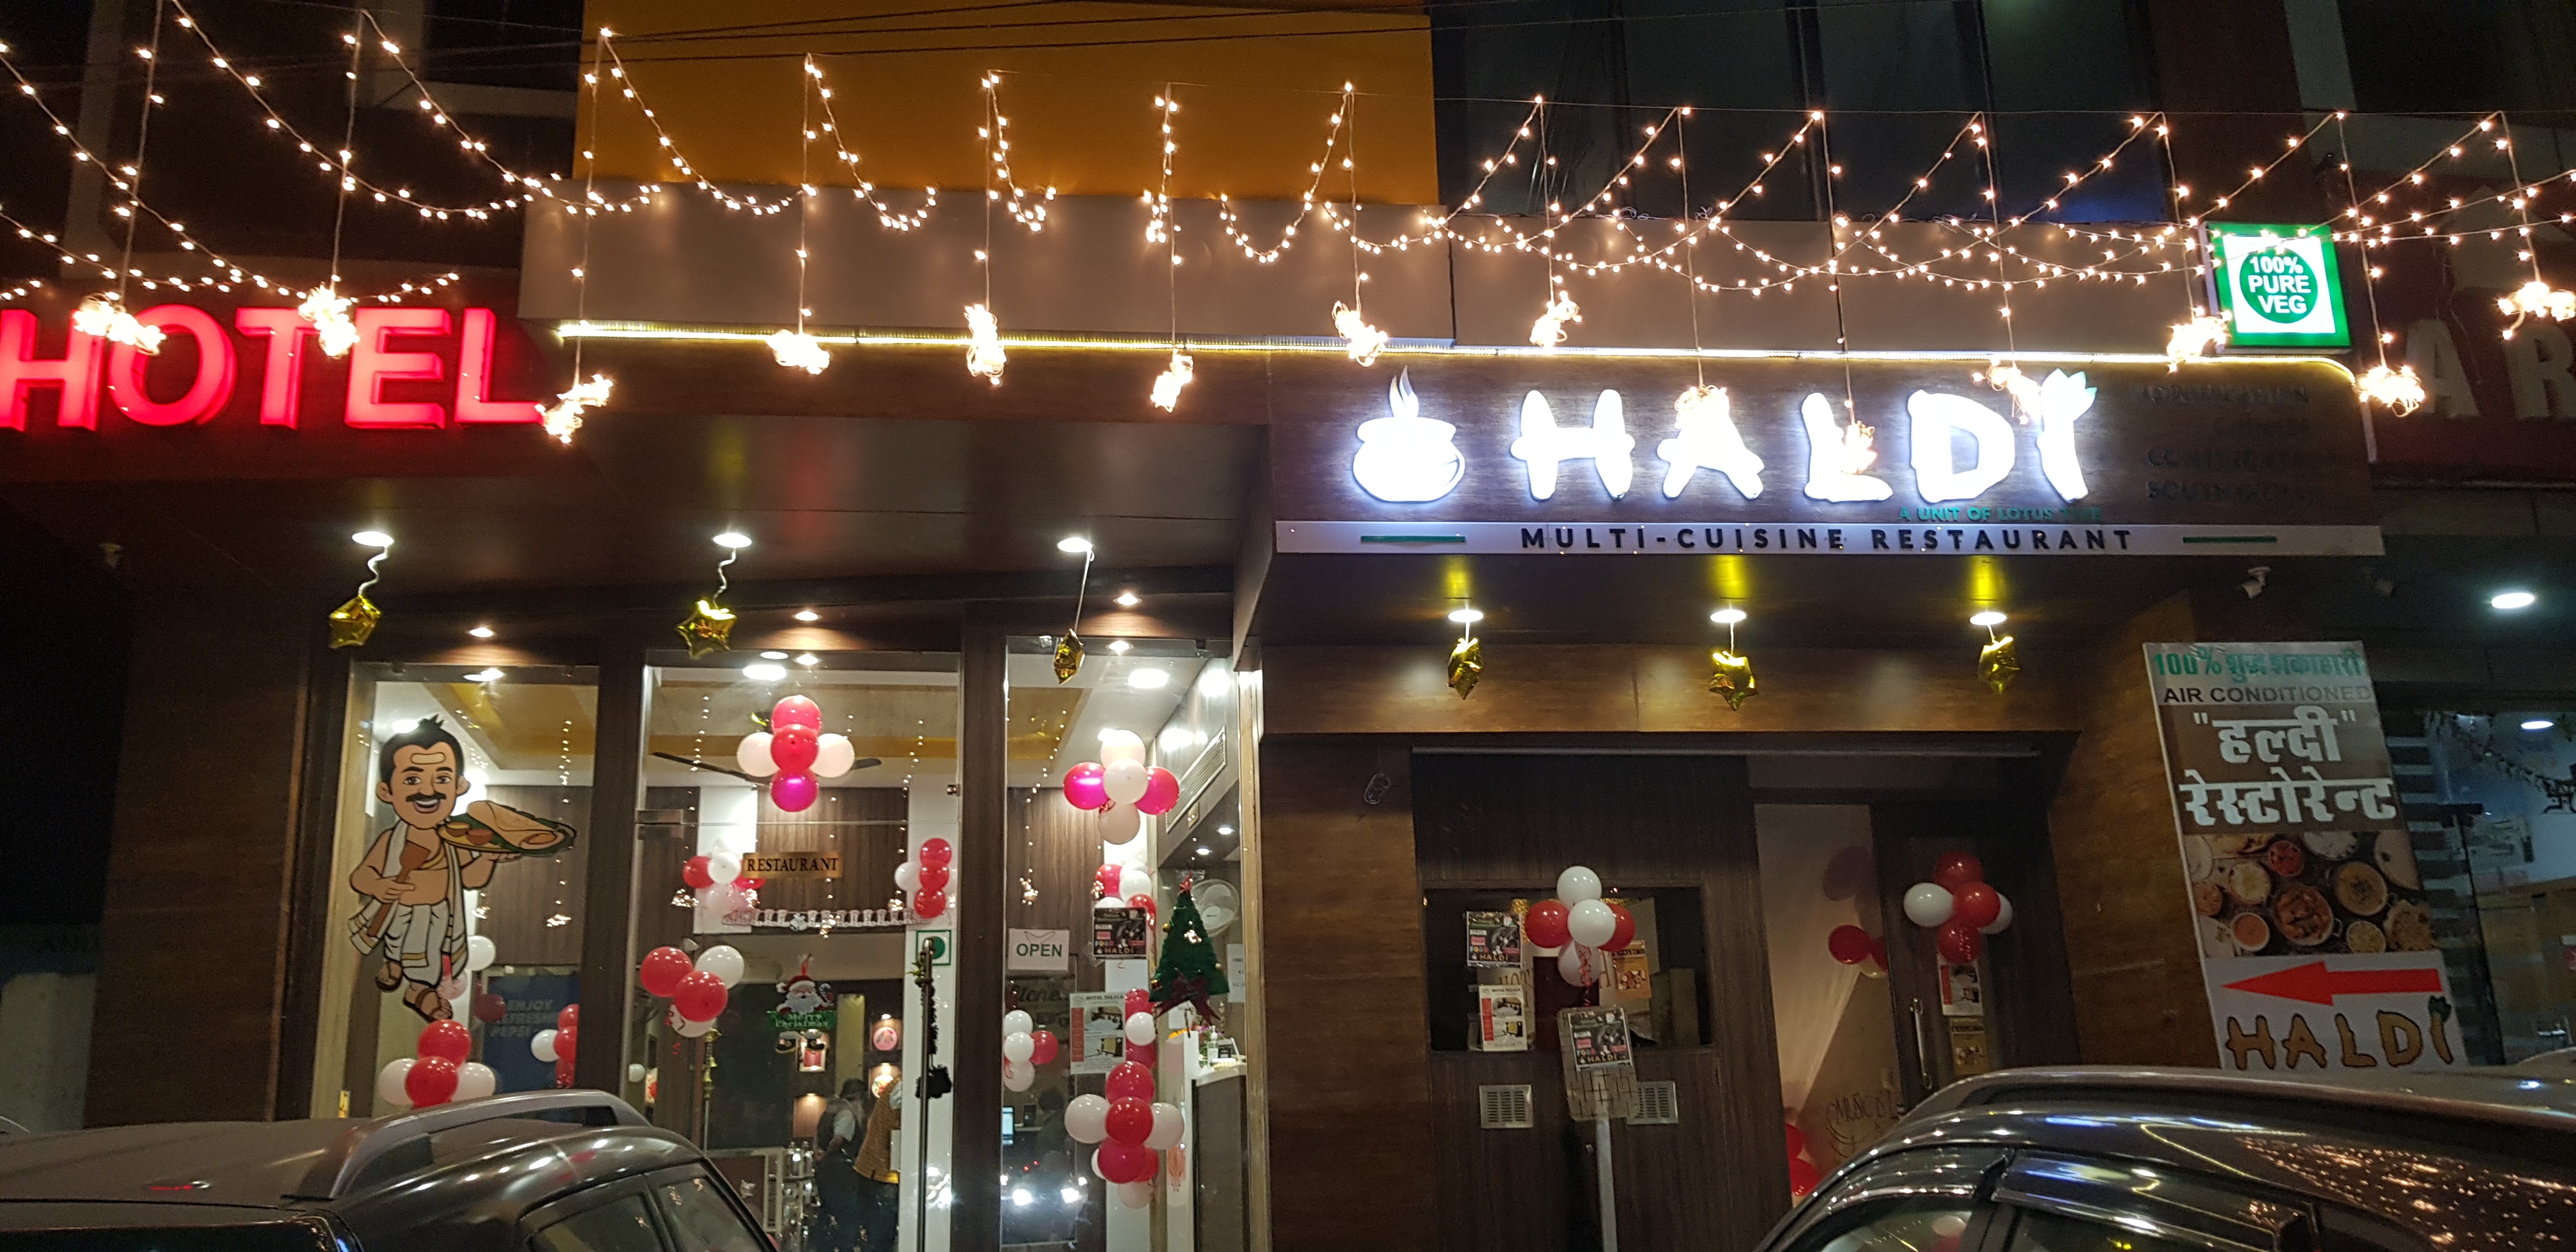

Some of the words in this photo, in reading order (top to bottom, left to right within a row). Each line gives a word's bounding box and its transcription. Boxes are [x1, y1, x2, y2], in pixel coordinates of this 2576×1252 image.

[2250, 256, 2304, 274] 100%
[2248, 275, 2312, 293] PURE
[2257, 294, 2307, 314] VEG
[0, 304, 547, 432] HOTEL
[1510, 369, 2097, 503] HALDI
[1897, 507, 1912, 521] A
[1917, 507, 1960, 521] UNIT
[1968, 507, 1991, 521] OF
[1997, 507, 2053, 521] LOTUS
[1521, 527, 1844, 549] MULTI-CUISINE
[1871, 529, 2130, 550] RESTAURANT
[2154, 646, 2223, 675] 100%
[2164, 687, 2204, 703] AIR
[2210, 685, 2372, 703] CONDITIONED
[2179, 766, 2397, 826] रेस्टोरेन्ट
[747, 857, 839, 872] RESTAURANT
[1016, 943, 1062, 957] OPEN
[2226, 995, 2453, 1070] HALDI
